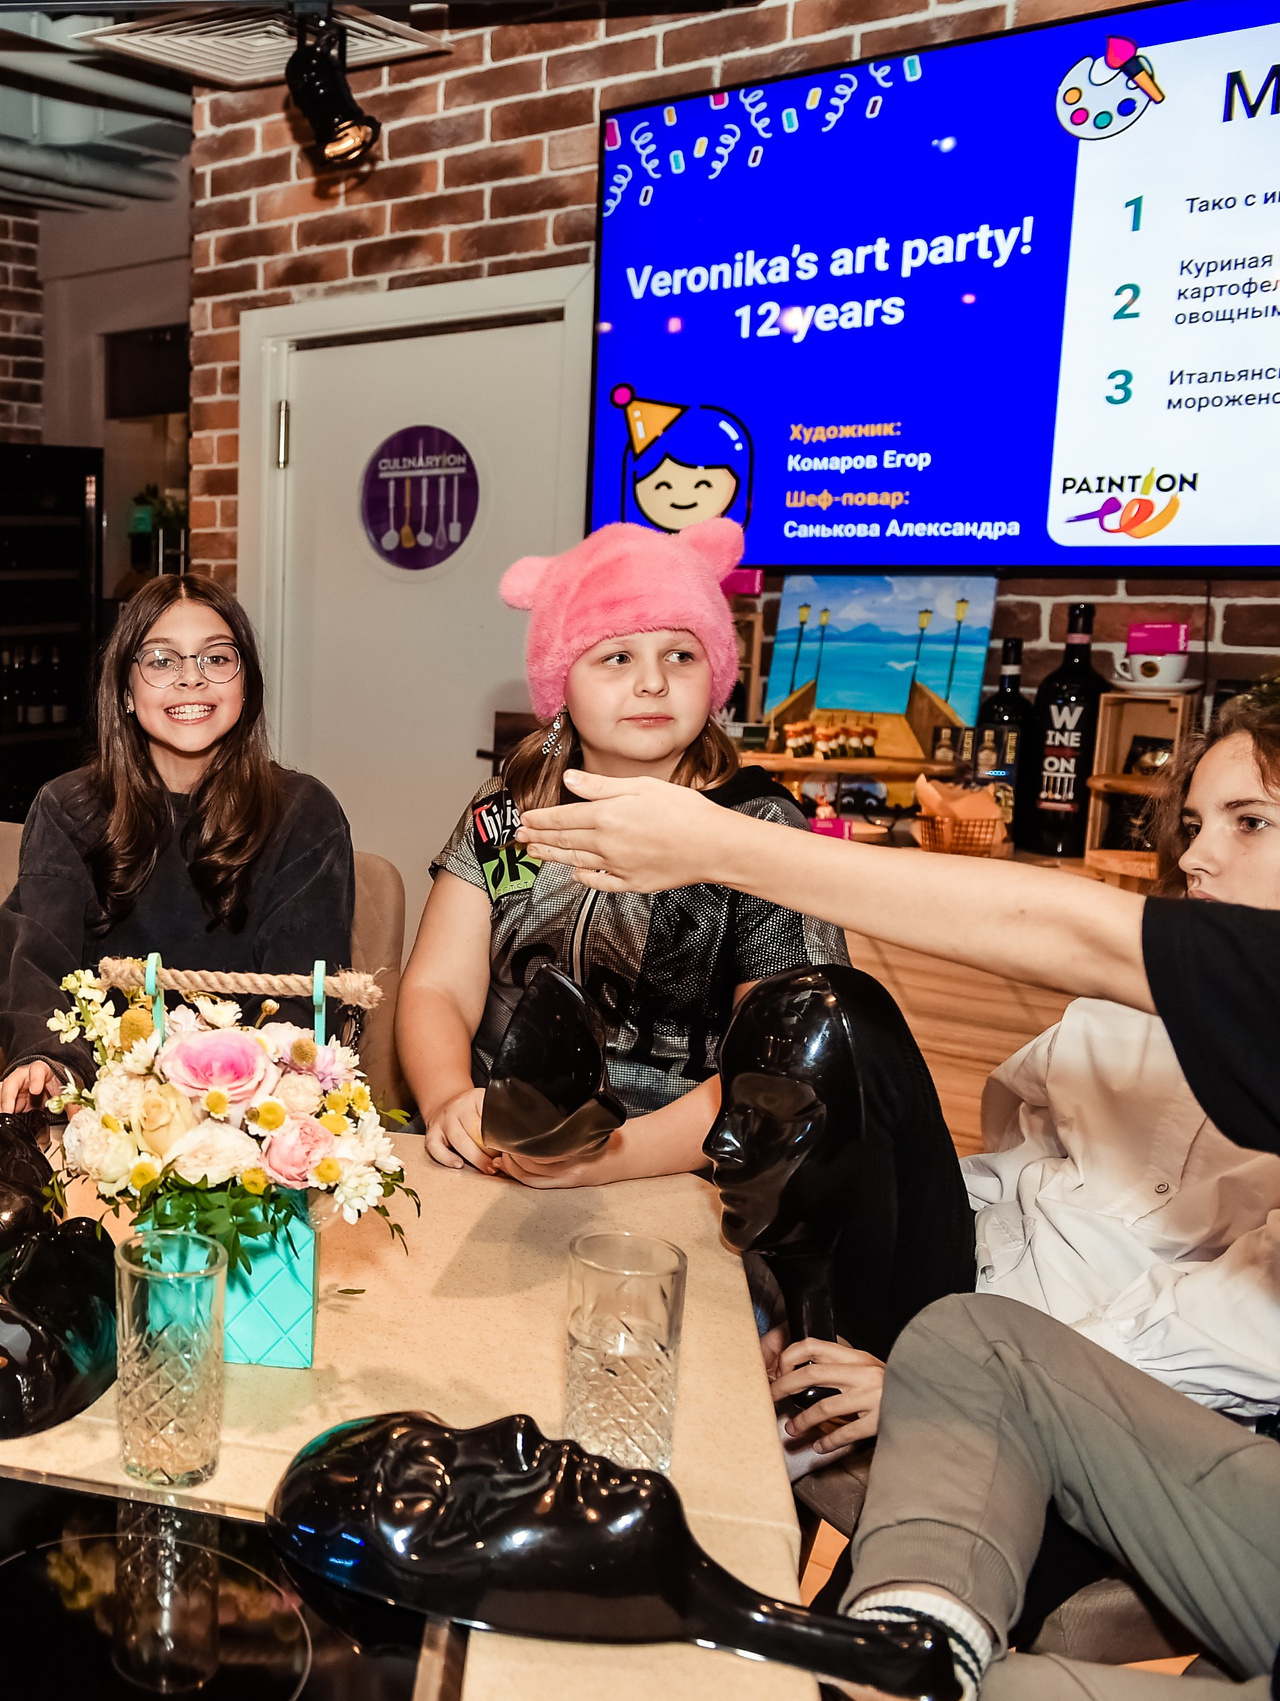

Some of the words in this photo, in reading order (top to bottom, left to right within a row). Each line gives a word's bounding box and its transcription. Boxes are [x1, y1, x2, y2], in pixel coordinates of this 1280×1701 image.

[1124, 194, 1144, 232] 1
[1185, 196, 1237, 214] Тако
[1244, 193, 1257, 207] с
[626, 244, 819, 300] Veronika’s
[829, 237, 890, 277] art
[900, 215, 1034, 278] party!
[1179, 254, 1274, 279] Куриная
[1112, 282, 1141, 320] 2
[734, 300, 782, 339] 12
[792, 296, 906, 344] years
[1105, 369, 1134, 405] 3
[1169, 367, 1280, 386] Итальянс
[789, 421, 902, 445] Художник:
[787, 454, 878, 474] Комаров
[883, 449, 932, 472] Егор
[785, 488, 910, 511] Шеф-повар:
[783, 520, 881, 538] Санькова
[885, 519, 1020, 541] Александра
[1043, 756, 1076, 773] ON
